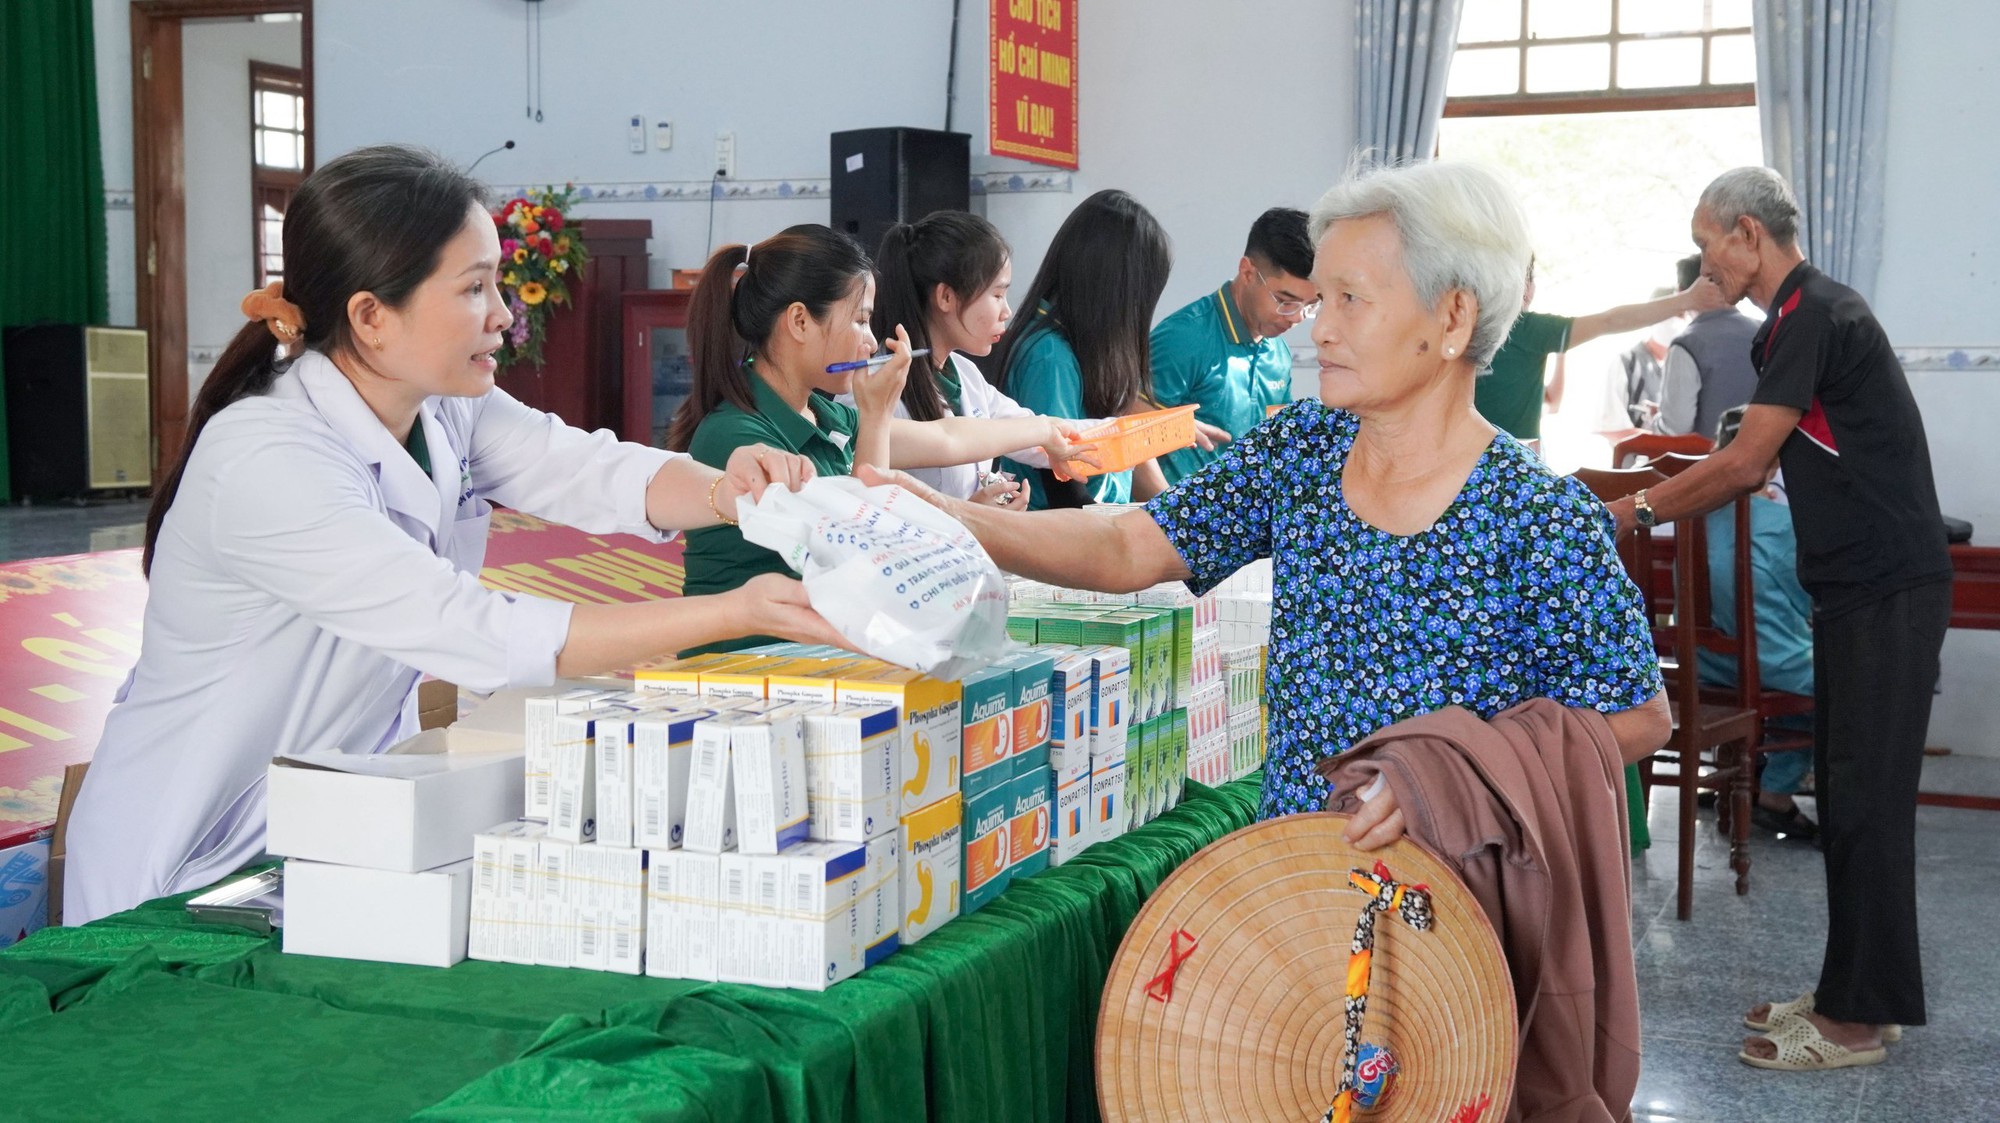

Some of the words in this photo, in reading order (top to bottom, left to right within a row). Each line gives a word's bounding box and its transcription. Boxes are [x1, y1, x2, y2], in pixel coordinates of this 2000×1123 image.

[1018, 42, 1038, 80] CHÍ
[1040, 50, 1070, 88] MINH
[921, 587, 940, 602] CHI
[1019, 683, 1048, 705] Aquima
[1101, 681, 1120, 698] GONPAT
[971, 697, 1006, 722] Aquima
[1067, 691, 1084, 710] GONPAT
[910, 707, 938, 725] Phospha
[1094, 776, 1114, 794] GONPAT
[1014, 790, 1046, 815] Aquima
[1060, 788, 1081, 808] GONPAT
[974, 809, 1005, 838] Aquima
[914, 835, 940, 855] Phospha
